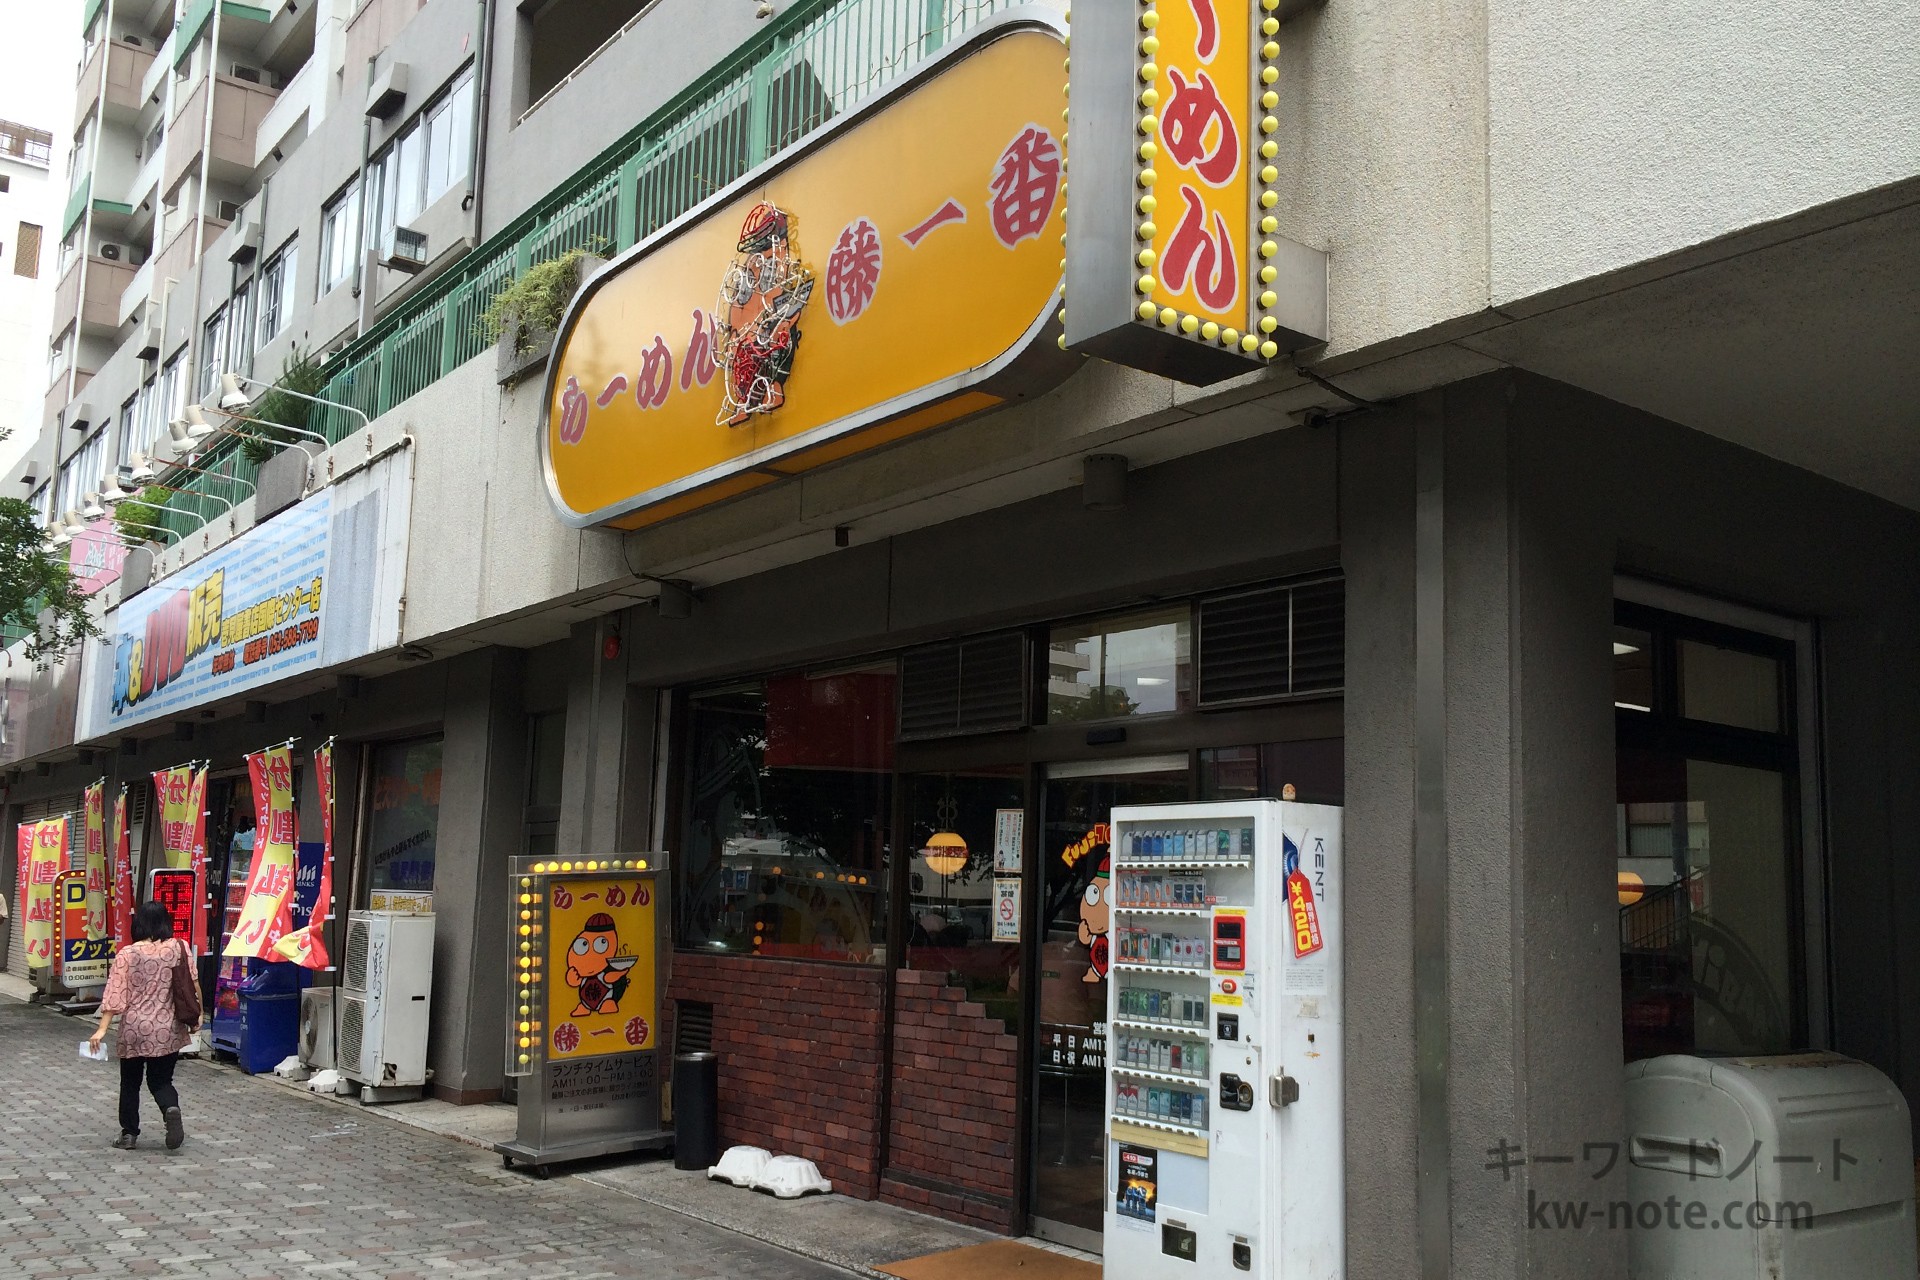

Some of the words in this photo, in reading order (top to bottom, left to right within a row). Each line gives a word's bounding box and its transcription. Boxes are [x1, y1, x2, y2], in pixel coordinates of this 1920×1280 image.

[1314, 837, 1324, 901] KENT
[553, 882, 650, 909] らーめん
[1290, 881, 1312, 950] ¥420
[552, 1054, 654, 1078] ランチタイムサービス
